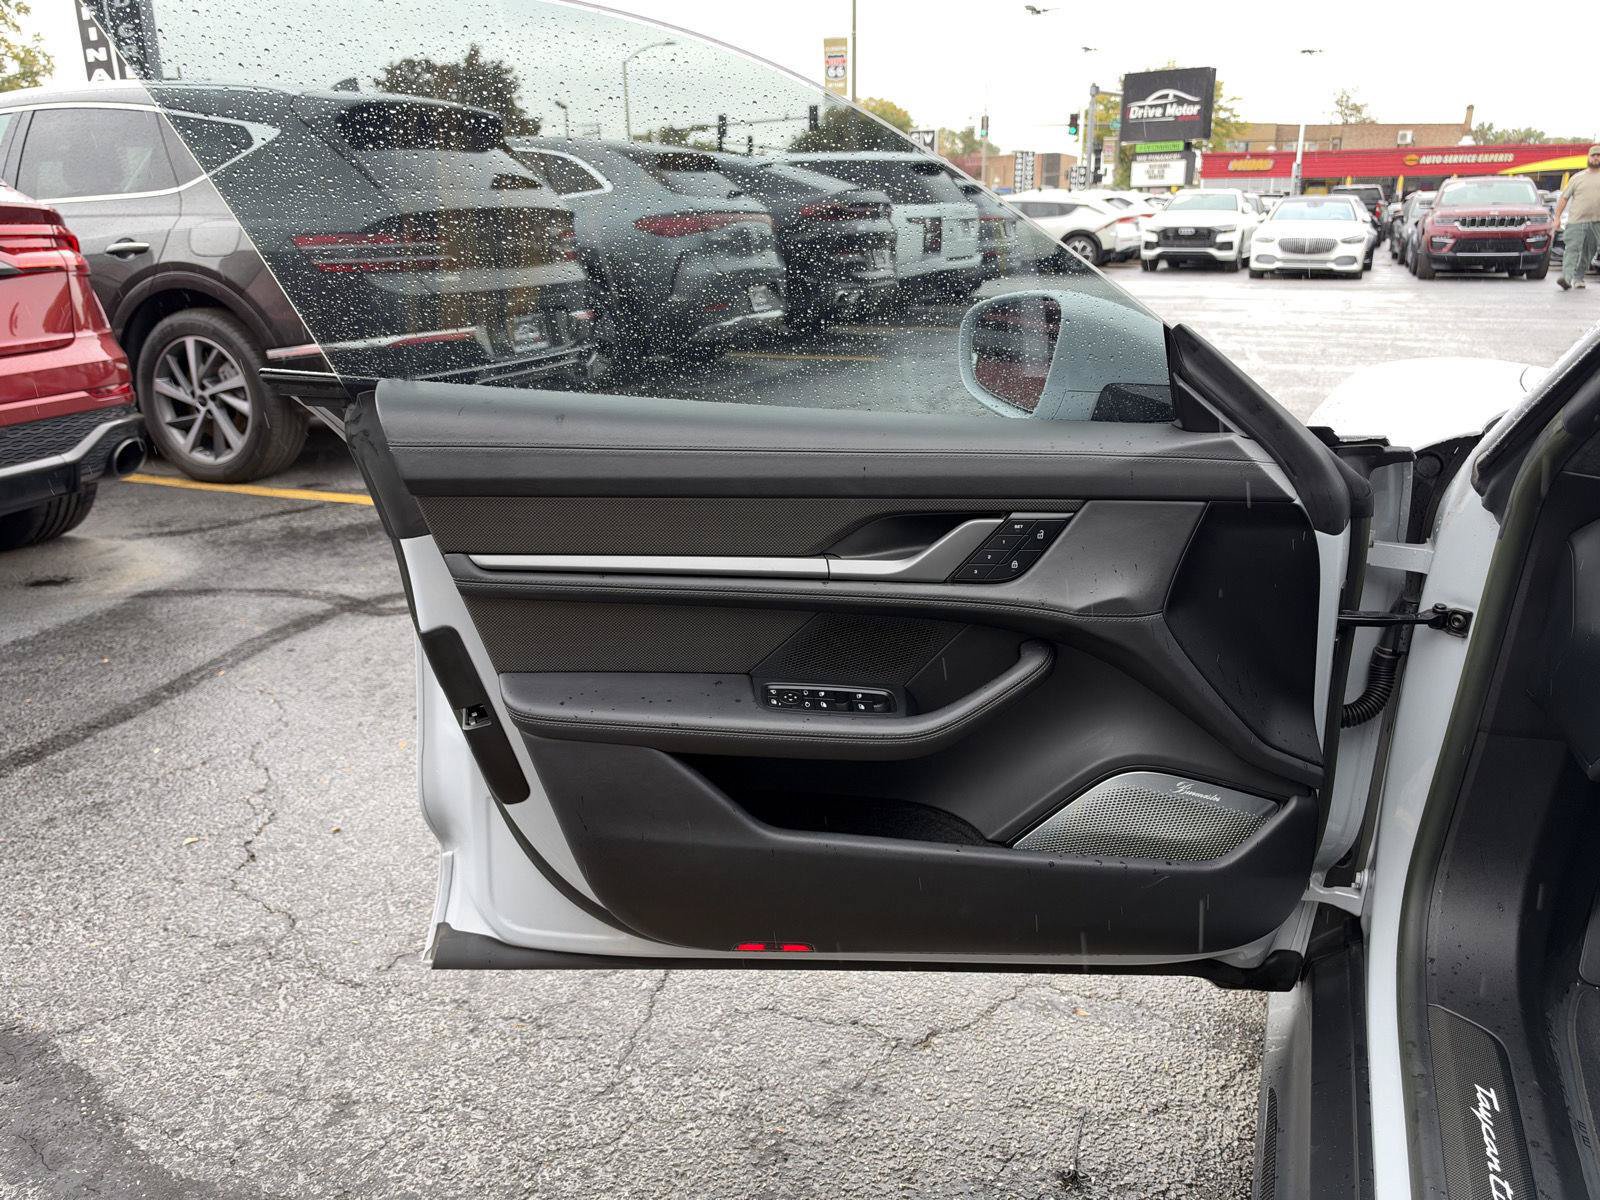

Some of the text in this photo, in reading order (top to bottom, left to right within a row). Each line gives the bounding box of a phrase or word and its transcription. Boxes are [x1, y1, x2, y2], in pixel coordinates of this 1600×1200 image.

[1129, 102, 1201, 119] Drive Motor
[1419, 152, 1514, 165] AUTO SERVICE EXPERTS
[1470, 1083, 1501, 1172] Taycan
